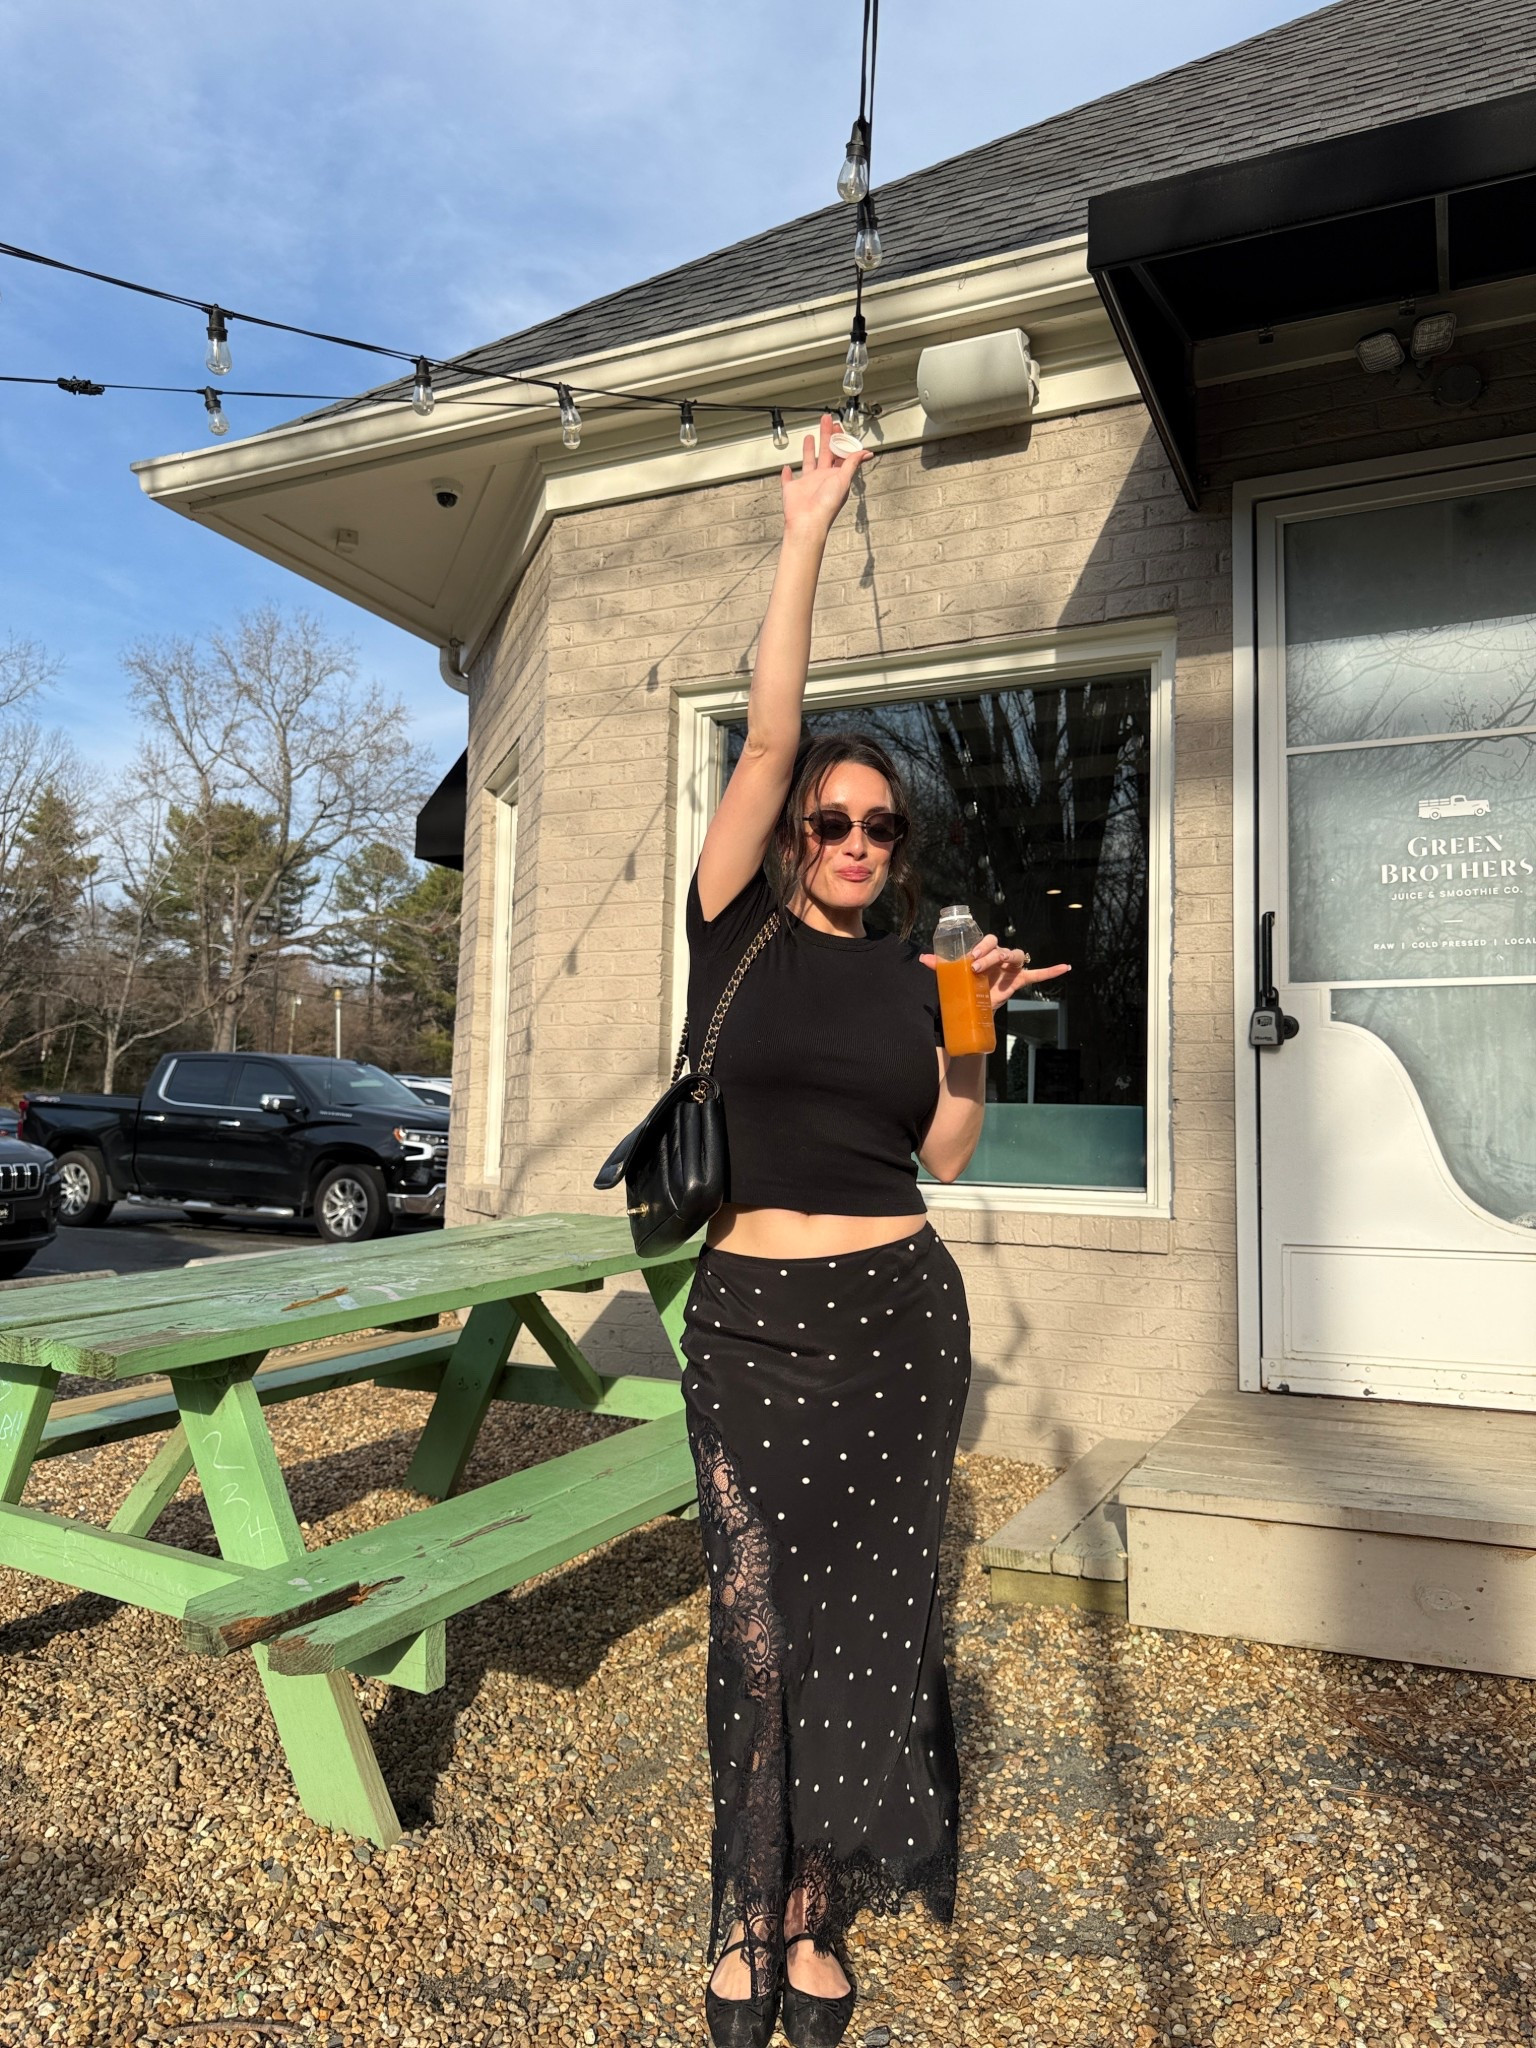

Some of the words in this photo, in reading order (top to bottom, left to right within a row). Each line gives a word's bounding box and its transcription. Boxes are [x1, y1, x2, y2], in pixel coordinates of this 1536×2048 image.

[1407, 834, 1503, 857] GREEN
[1381, 858, 1534, 884] BROTHERS
[1391, 891, 1423, 901] JUICE
[1427, 891, 1435, 899] &
[1439, 887, 1500, 898] SMOOTHIE
[1503, 885, 1523, 894] CO.
[1411, 941, 1439, 949] COLD
[1442, 939, 1487, 948] PRESSED
[202, 1430, 246, 1470] 2
[219, 1482, 251, 1534] 3
[247, 1515, 275, 1564] 4
